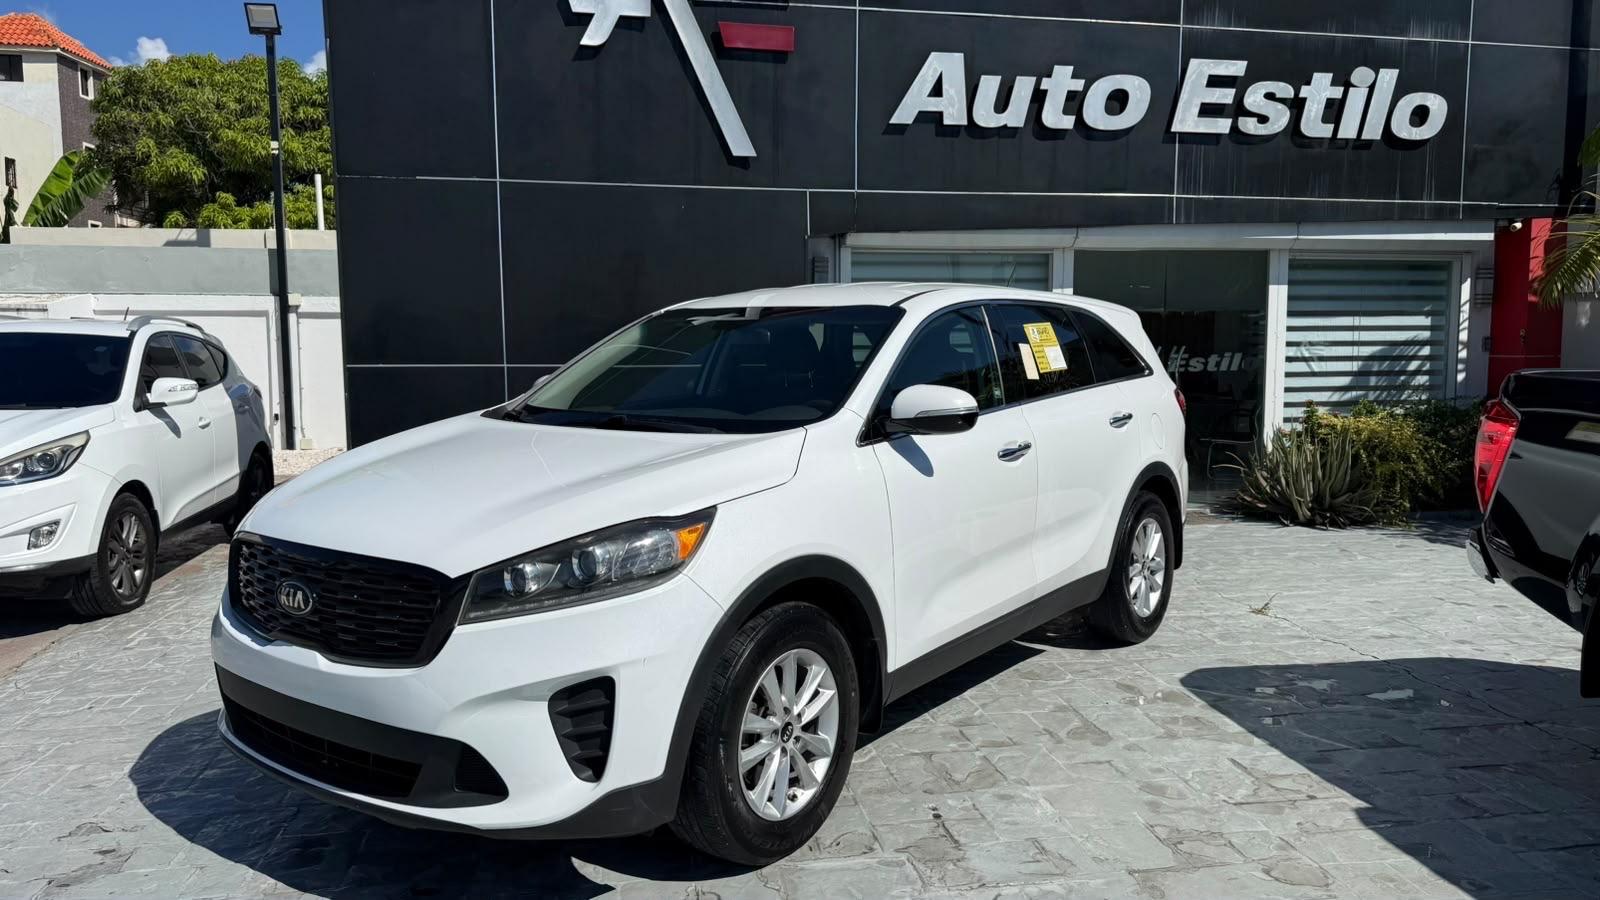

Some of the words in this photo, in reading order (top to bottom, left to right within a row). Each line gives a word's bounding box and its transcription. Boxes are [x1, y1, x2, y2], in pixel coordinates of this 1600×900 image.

[888, 51, 1152, 131] Auto
[1170, 58, 1449, 141] Estilo
[1168, 351, 1247, 373] Estil
[280, 586, 306, 610] KIA
